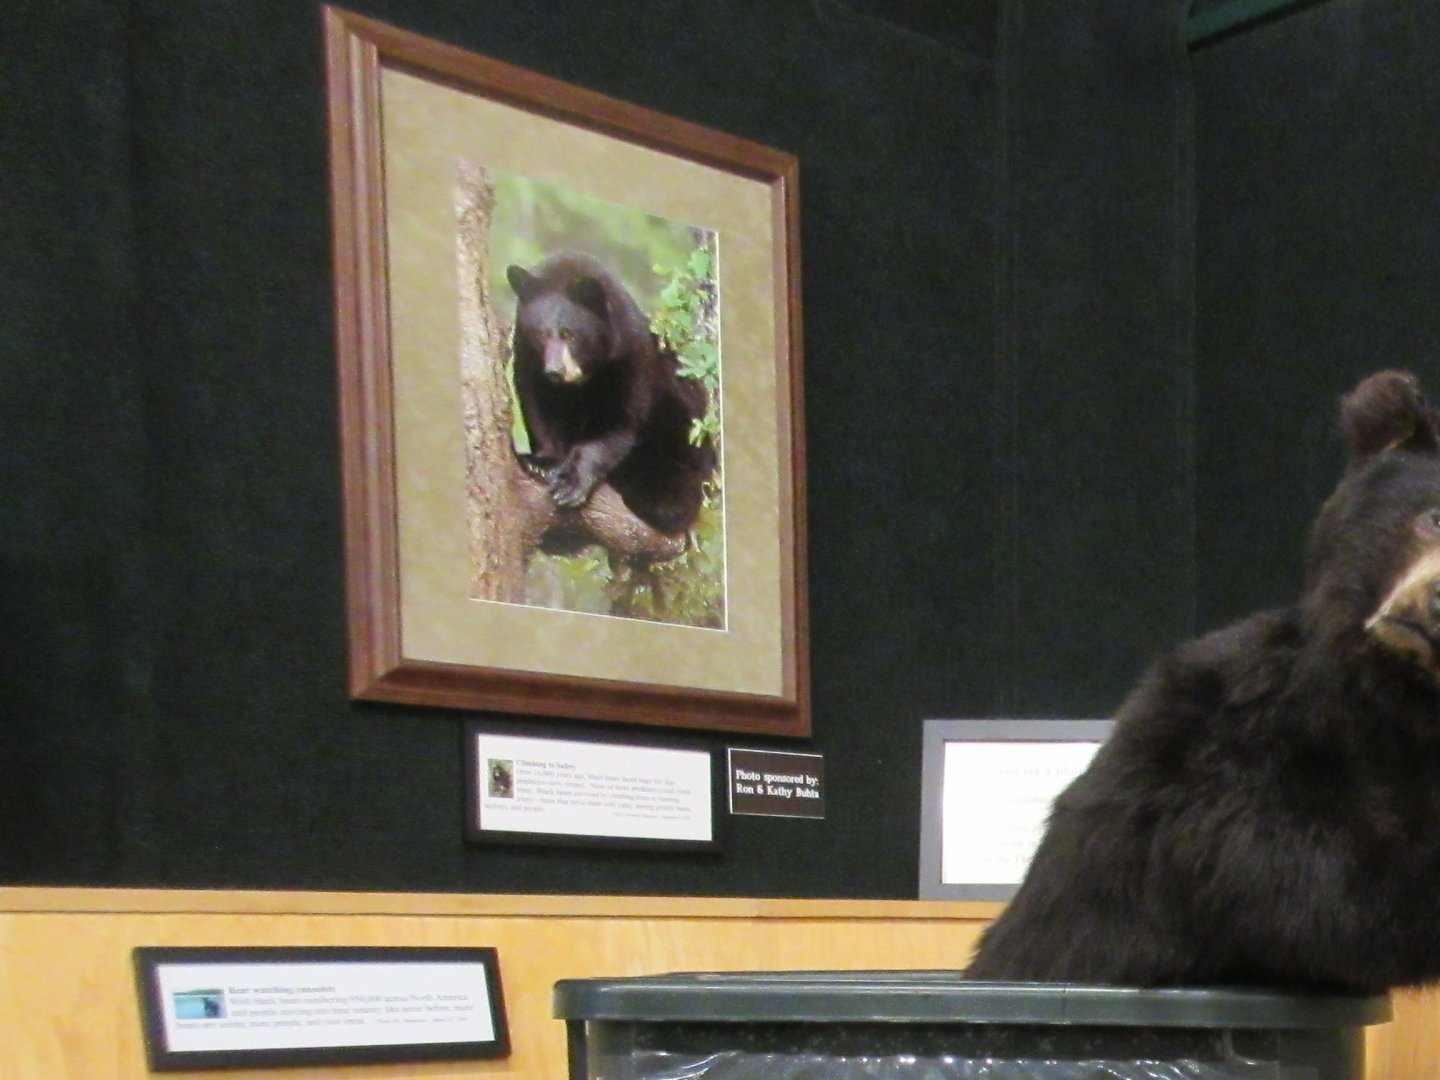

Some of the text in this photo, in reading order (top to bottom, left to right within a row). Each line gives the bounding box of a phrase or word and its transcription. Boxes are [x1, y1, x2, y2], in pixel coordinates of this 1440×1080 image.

[735, 769, 819, 787] Photo sponsored by:
[735, 783, 754, 794] Ron
[757, 784, 764, 795] &
[766, 785, 793, 798] Kathy
